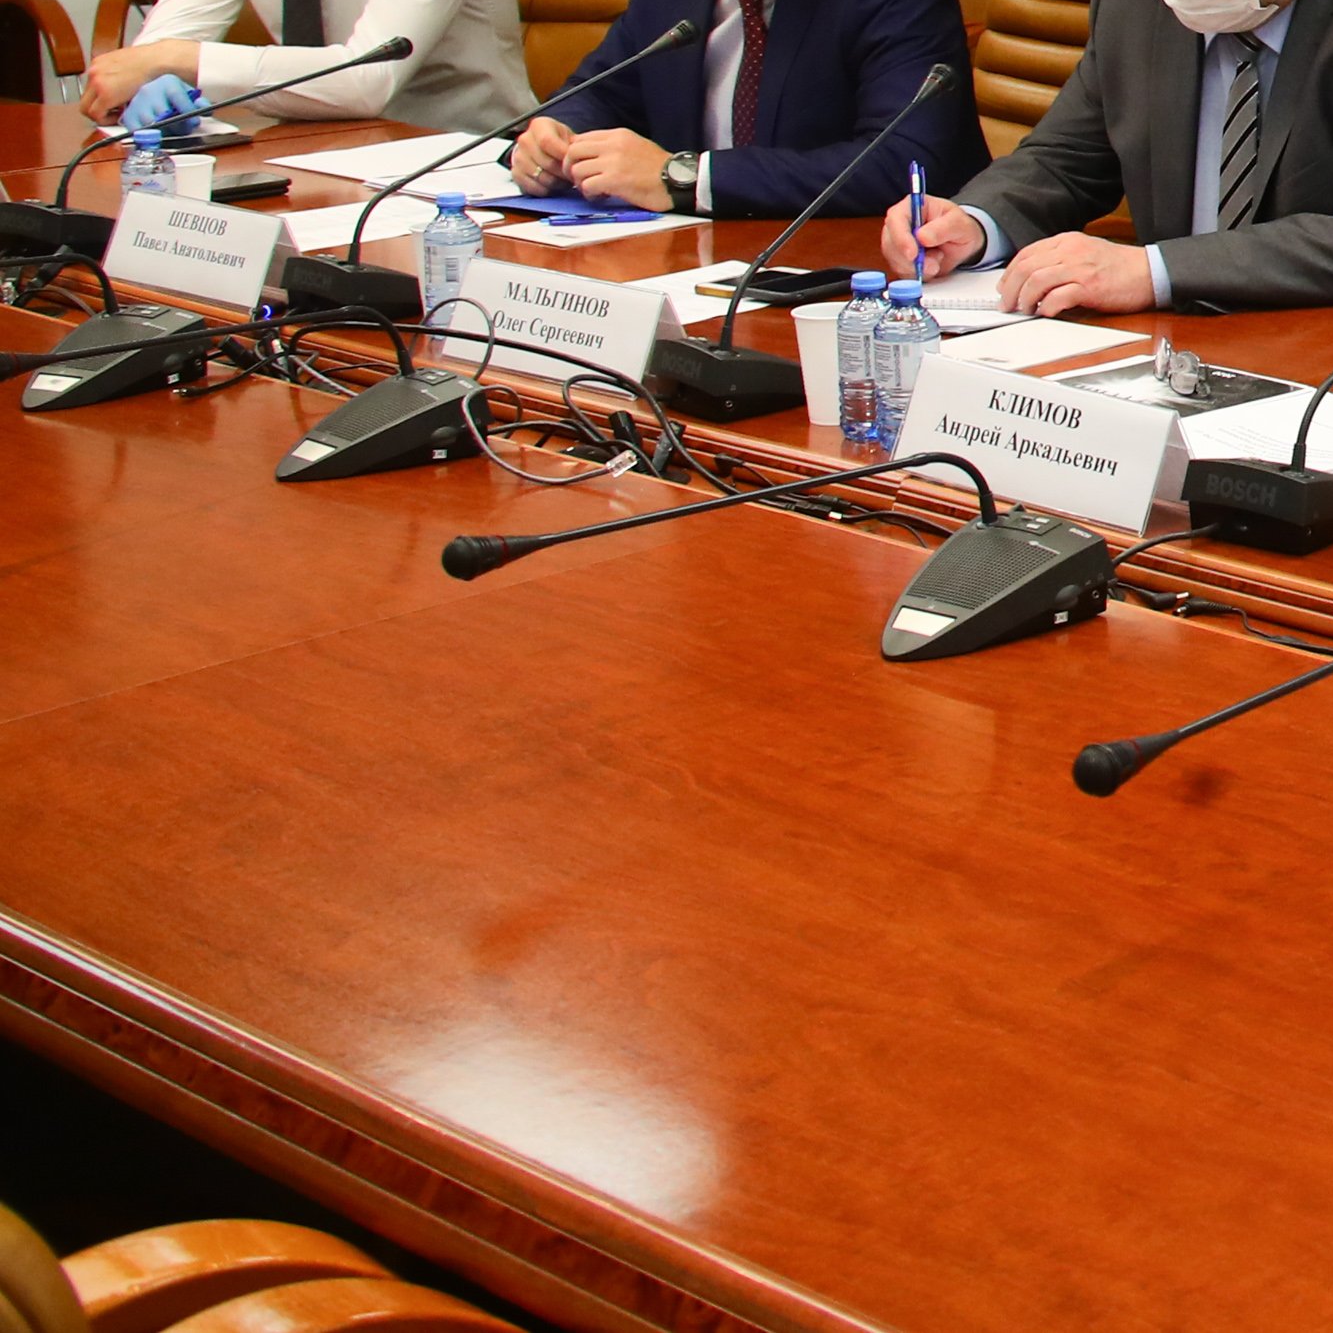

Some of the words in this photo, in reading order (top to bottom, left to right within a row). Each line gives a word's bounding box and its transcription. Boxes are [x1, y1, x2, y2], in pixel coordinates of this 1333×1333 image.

[167, 210, 228, 237] ШЕВЦОВ
[132, 230, 168, 251] Павел
[169, 239, 246, 268] Анатольевич
[503, 281, 611, 318] МАЛЬГИНОВ
[492, 310, 527, 333] Олег
[529, 317, 605, 350] Сергеевич
[988, 388, 1083, 430] КЛИМОВ
[935, 413, 1002, 447] Андрей
[1004, 431, 1119, 477] Аркадьевич
[1206, 472, 1277, 509] BOSCH
